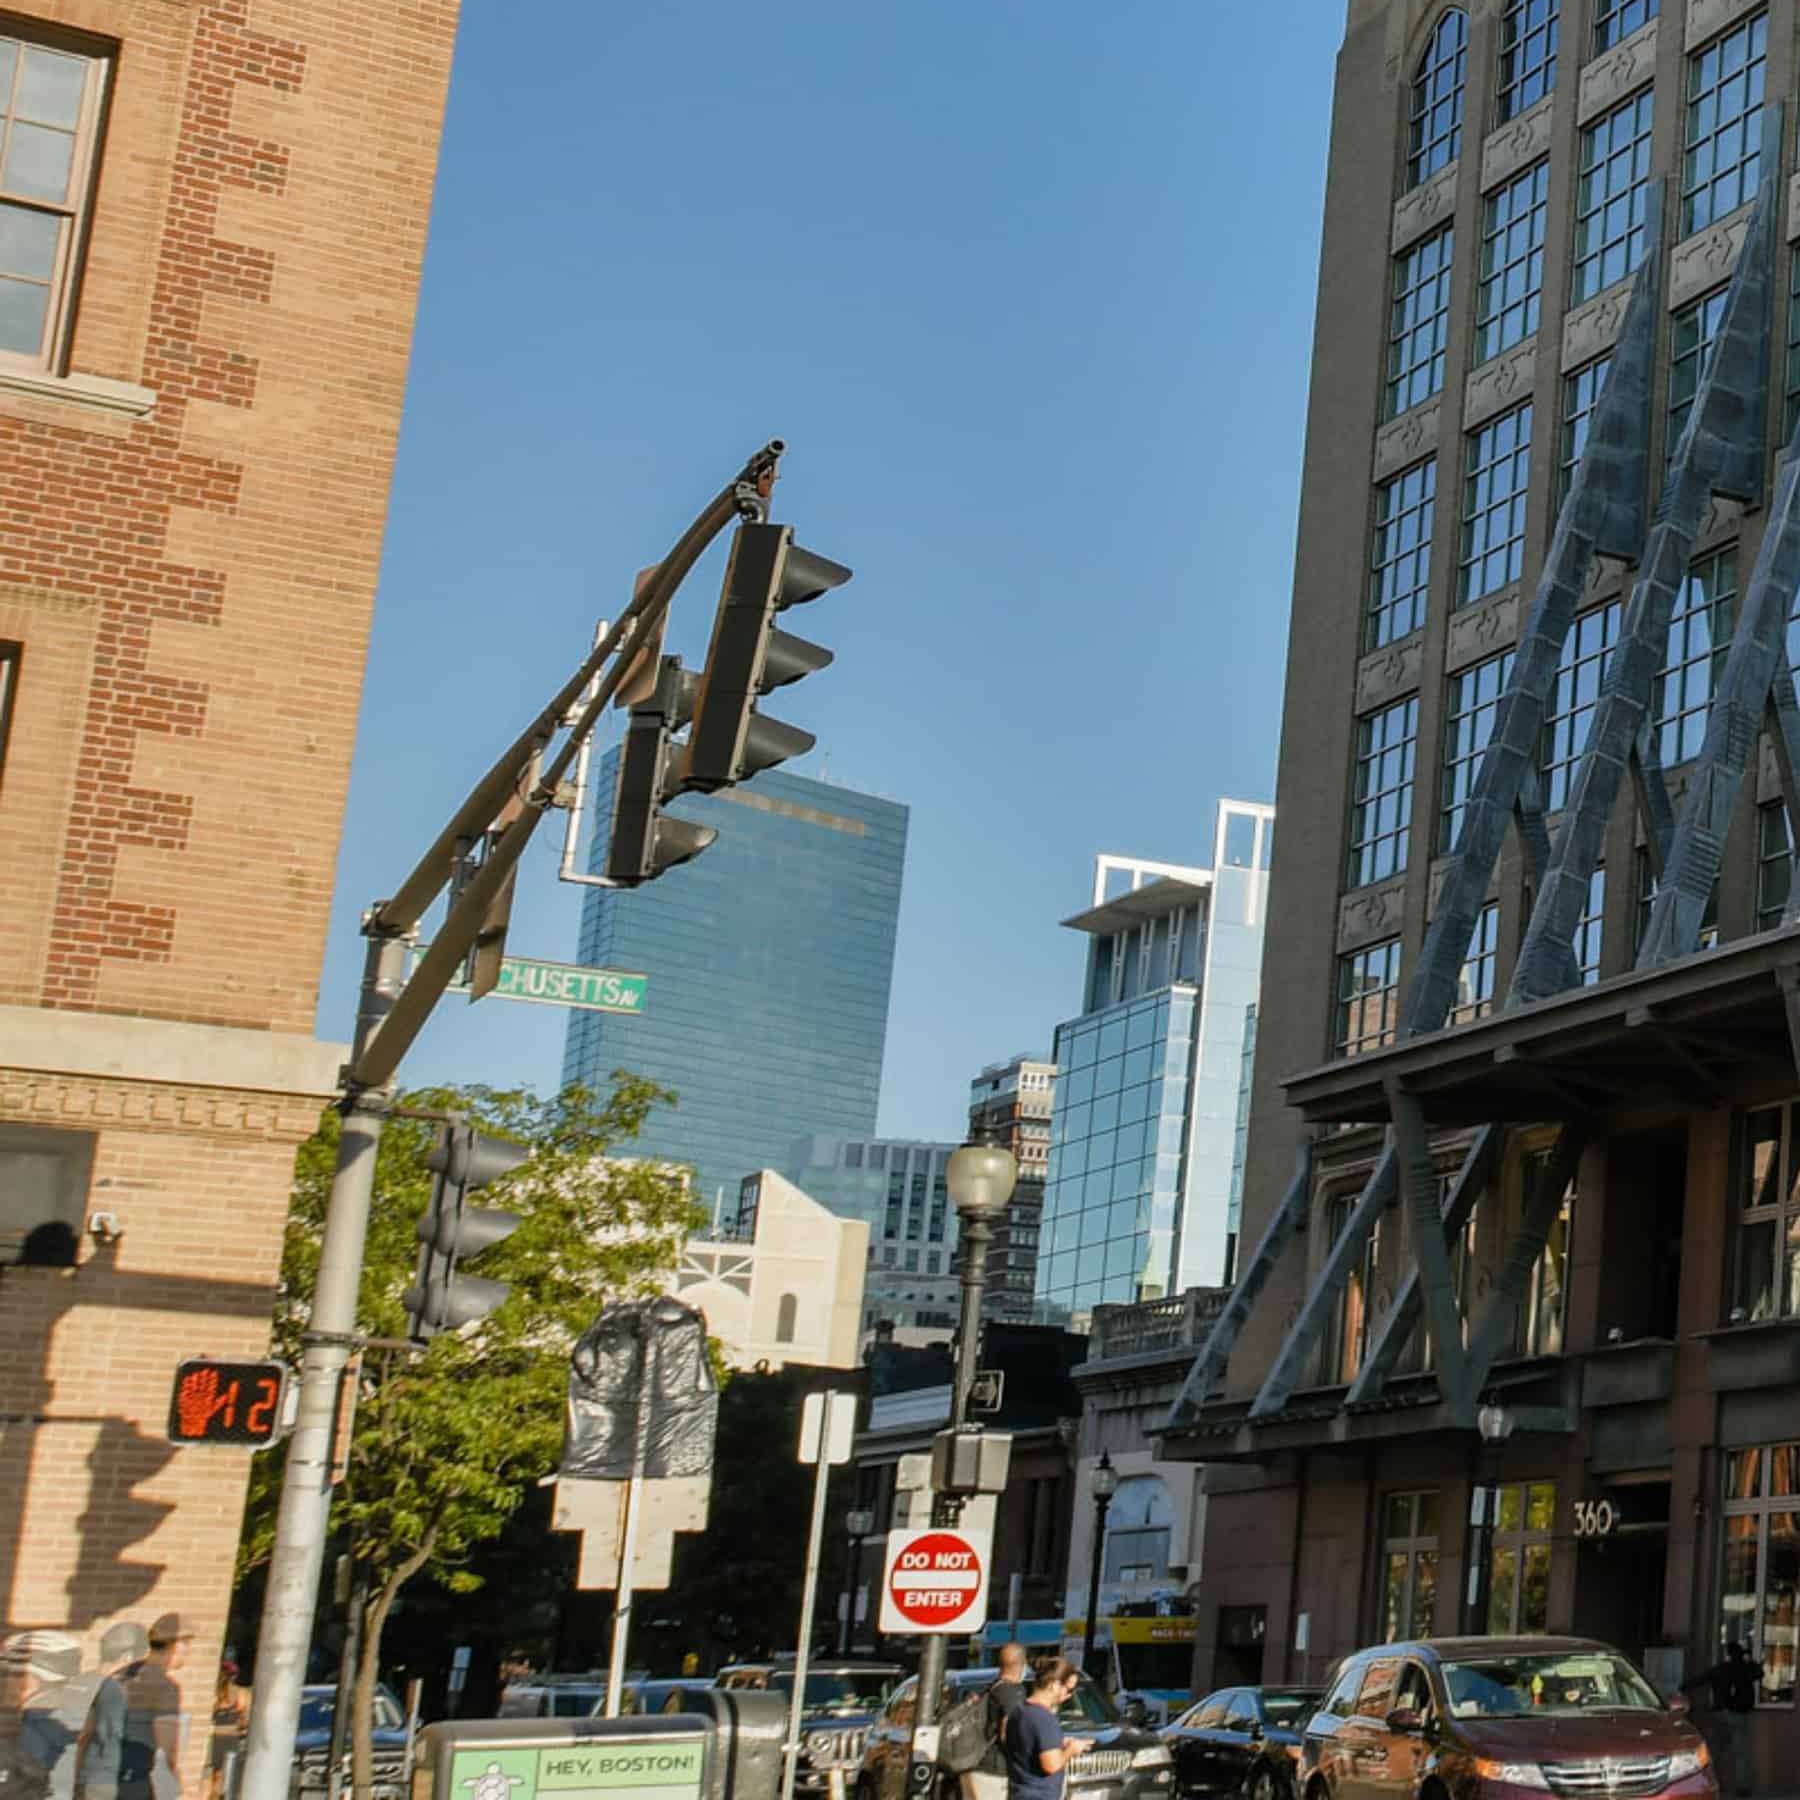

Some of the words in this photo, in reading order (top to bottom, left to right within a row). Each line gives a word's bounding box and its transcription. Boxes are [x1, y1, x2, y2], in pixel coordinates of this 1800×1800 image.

[1572, 1500, 1613, 1536] 360
[902, 1552, 931, 1569] DO
[935, 1552, 973, 1569] NOT
[904, 1591, 963, 1608] ENTER
[546, 1759, 592, 1778] HEY,
[599, 1755, 695, 1775] BOSTON!
